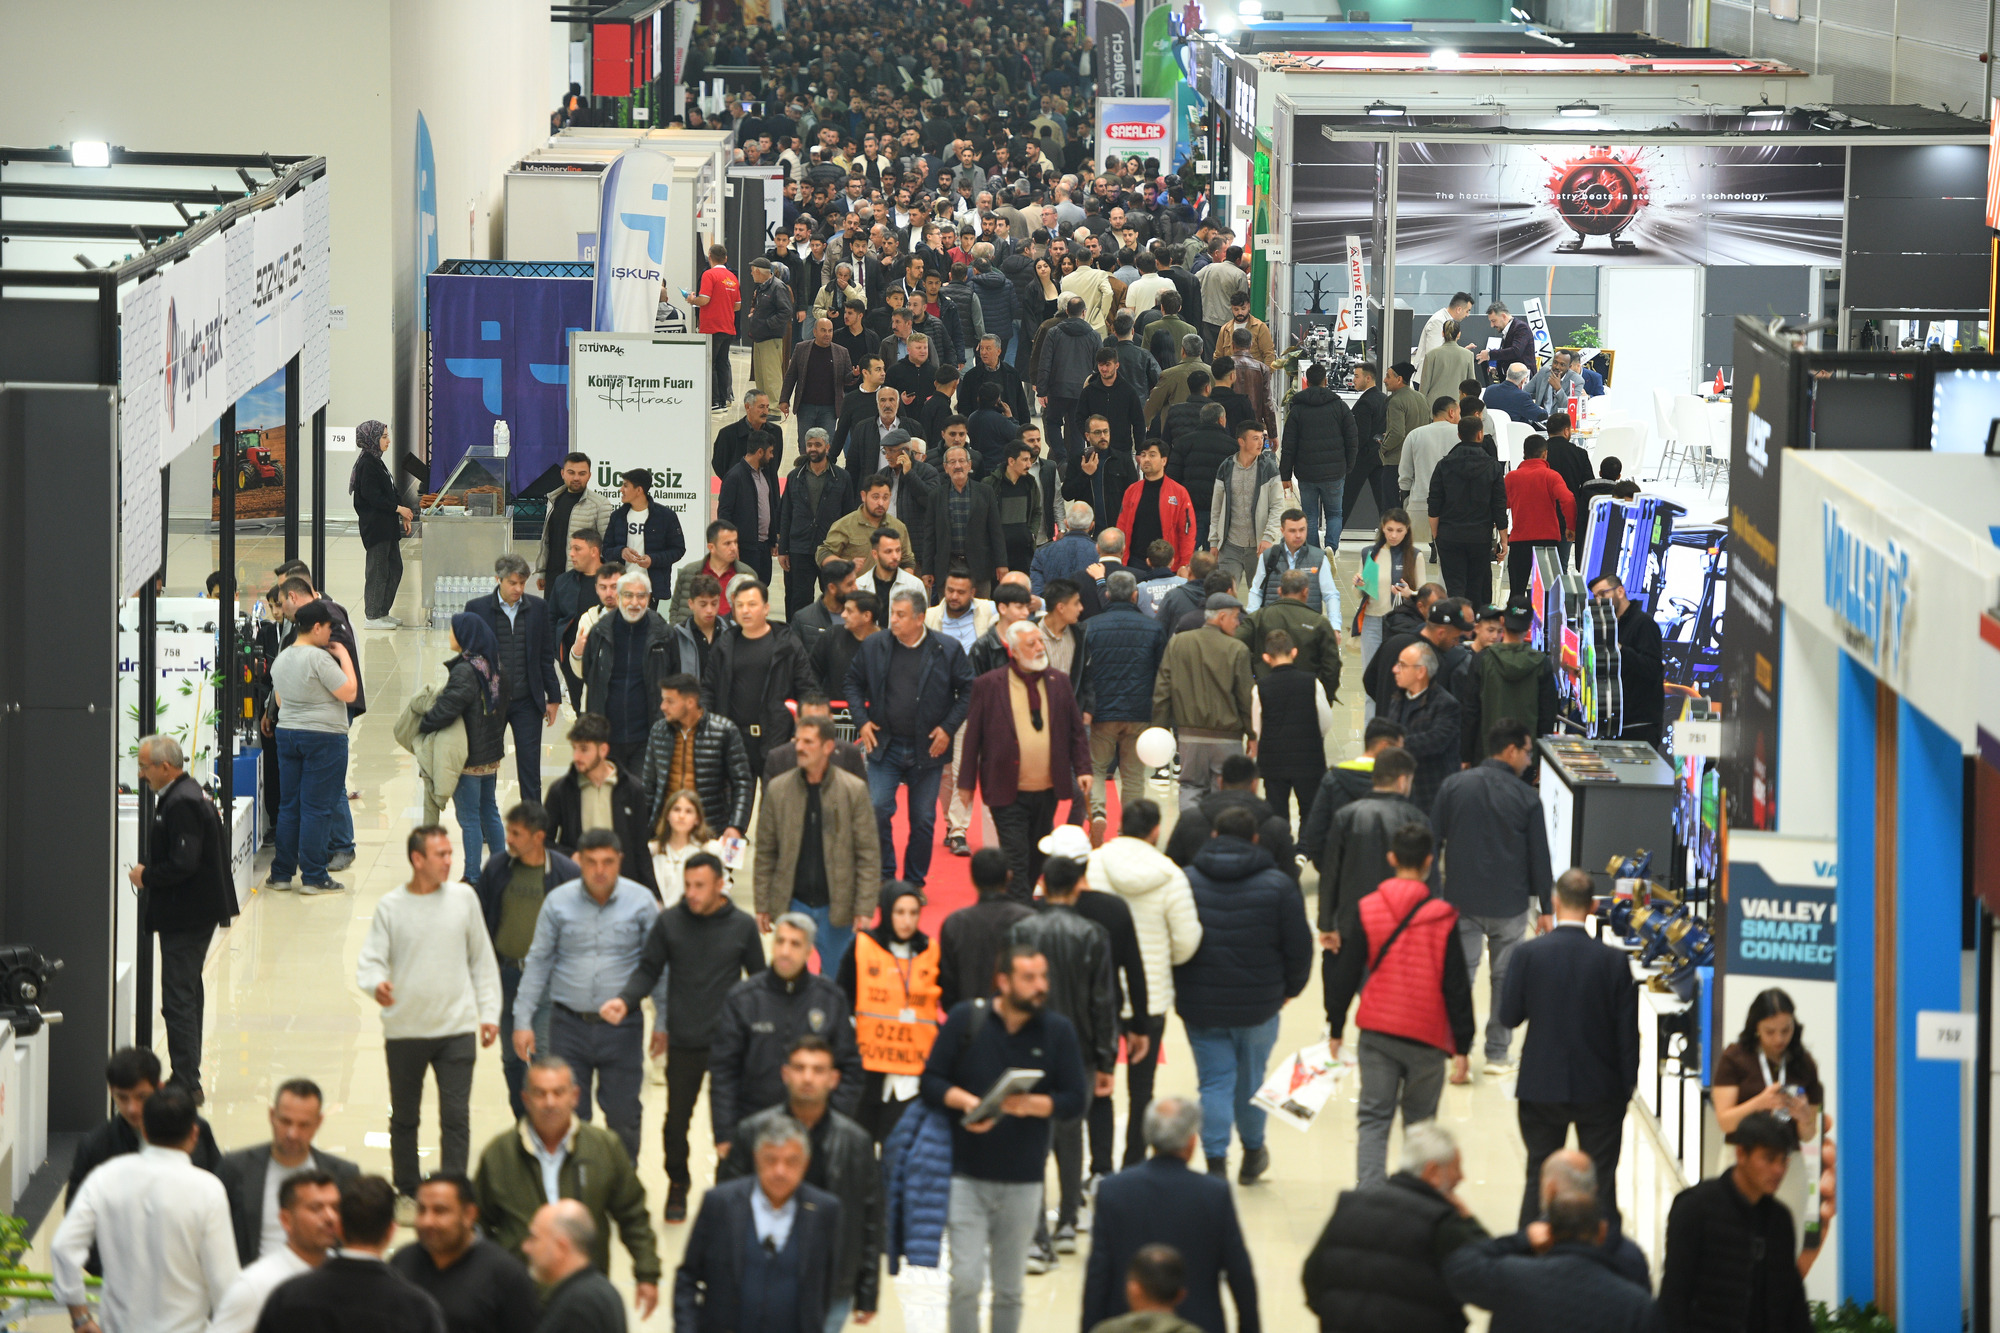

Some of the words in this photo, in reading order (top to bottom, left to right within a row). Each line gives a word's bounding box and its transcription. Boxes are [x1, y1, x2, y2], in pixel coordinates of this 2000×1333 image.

[1435, 192, 1454, 200] The
[1459, 192, 1489, 200] heart
[1701, 192, 1768, 202] technology.
[1352, 260, 1362, 292] ATİYE
[588, 375, 624, 390] Konya
[627, 376, 660, 389] Tarım
[663, 377, 693, 389] Fuarı
[332, 434, 346, 443] 759
[653, 490, 697, 500] Alanımıza
[164, 648, 181, 657] 758
[1741, 898, 1827, 923] VALLEY
[1741, 919, 1823, 942] SMART
